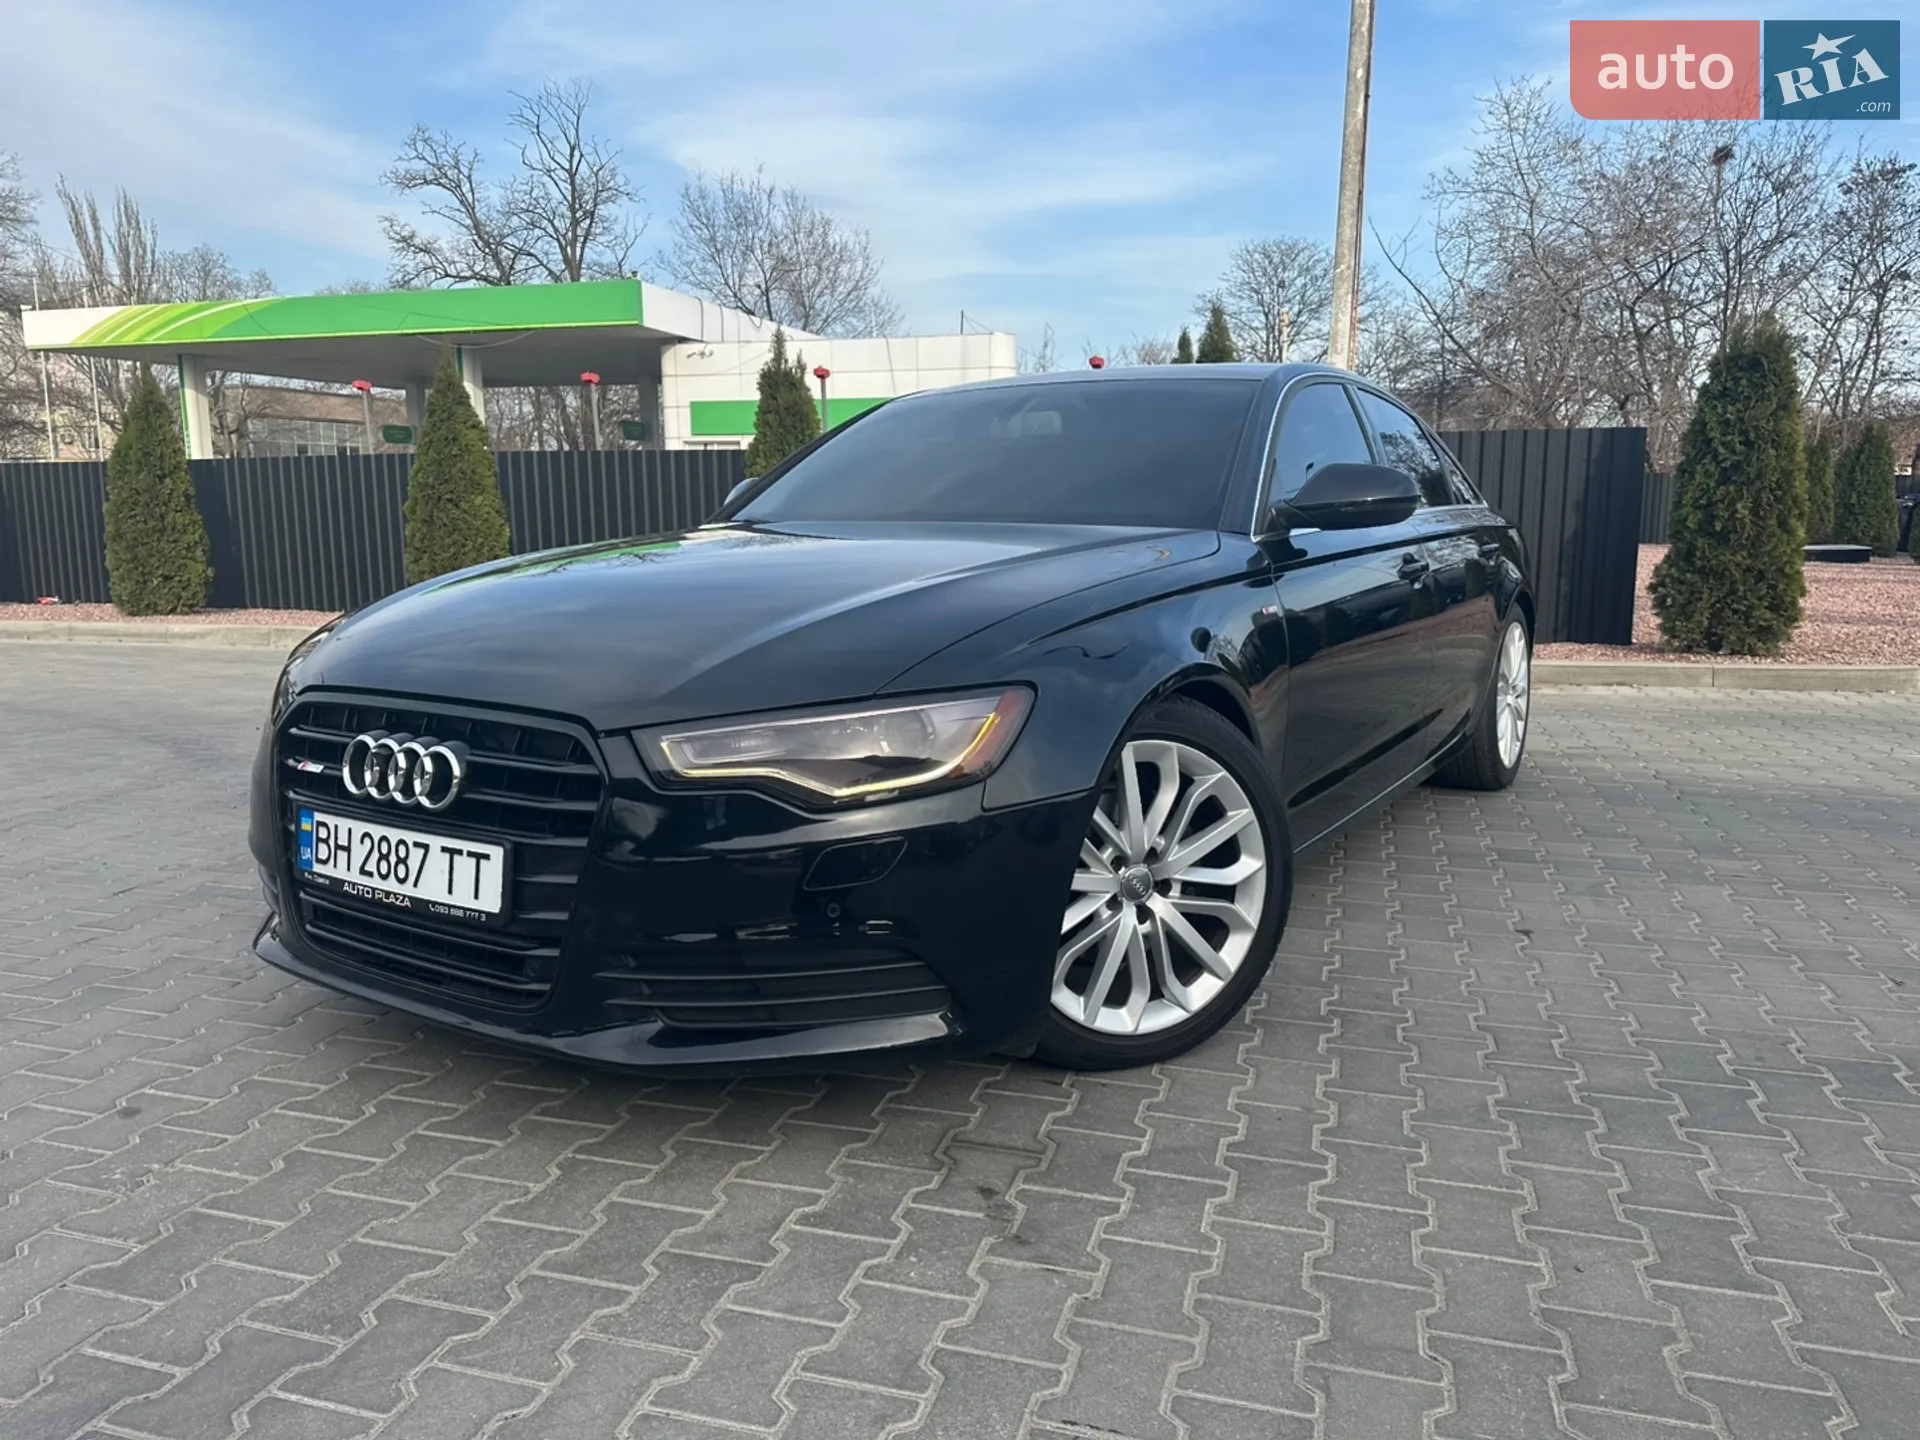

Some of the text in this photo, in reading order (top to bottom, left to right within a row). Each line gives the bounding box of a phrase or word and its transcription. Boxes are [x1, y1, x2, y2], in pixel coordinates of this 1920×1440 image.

[301, 846, 312, 861] UA
[315, 820, 491, 900] BH 2887 TT
[343, 882, 412, 908] AUTO PLAZA
